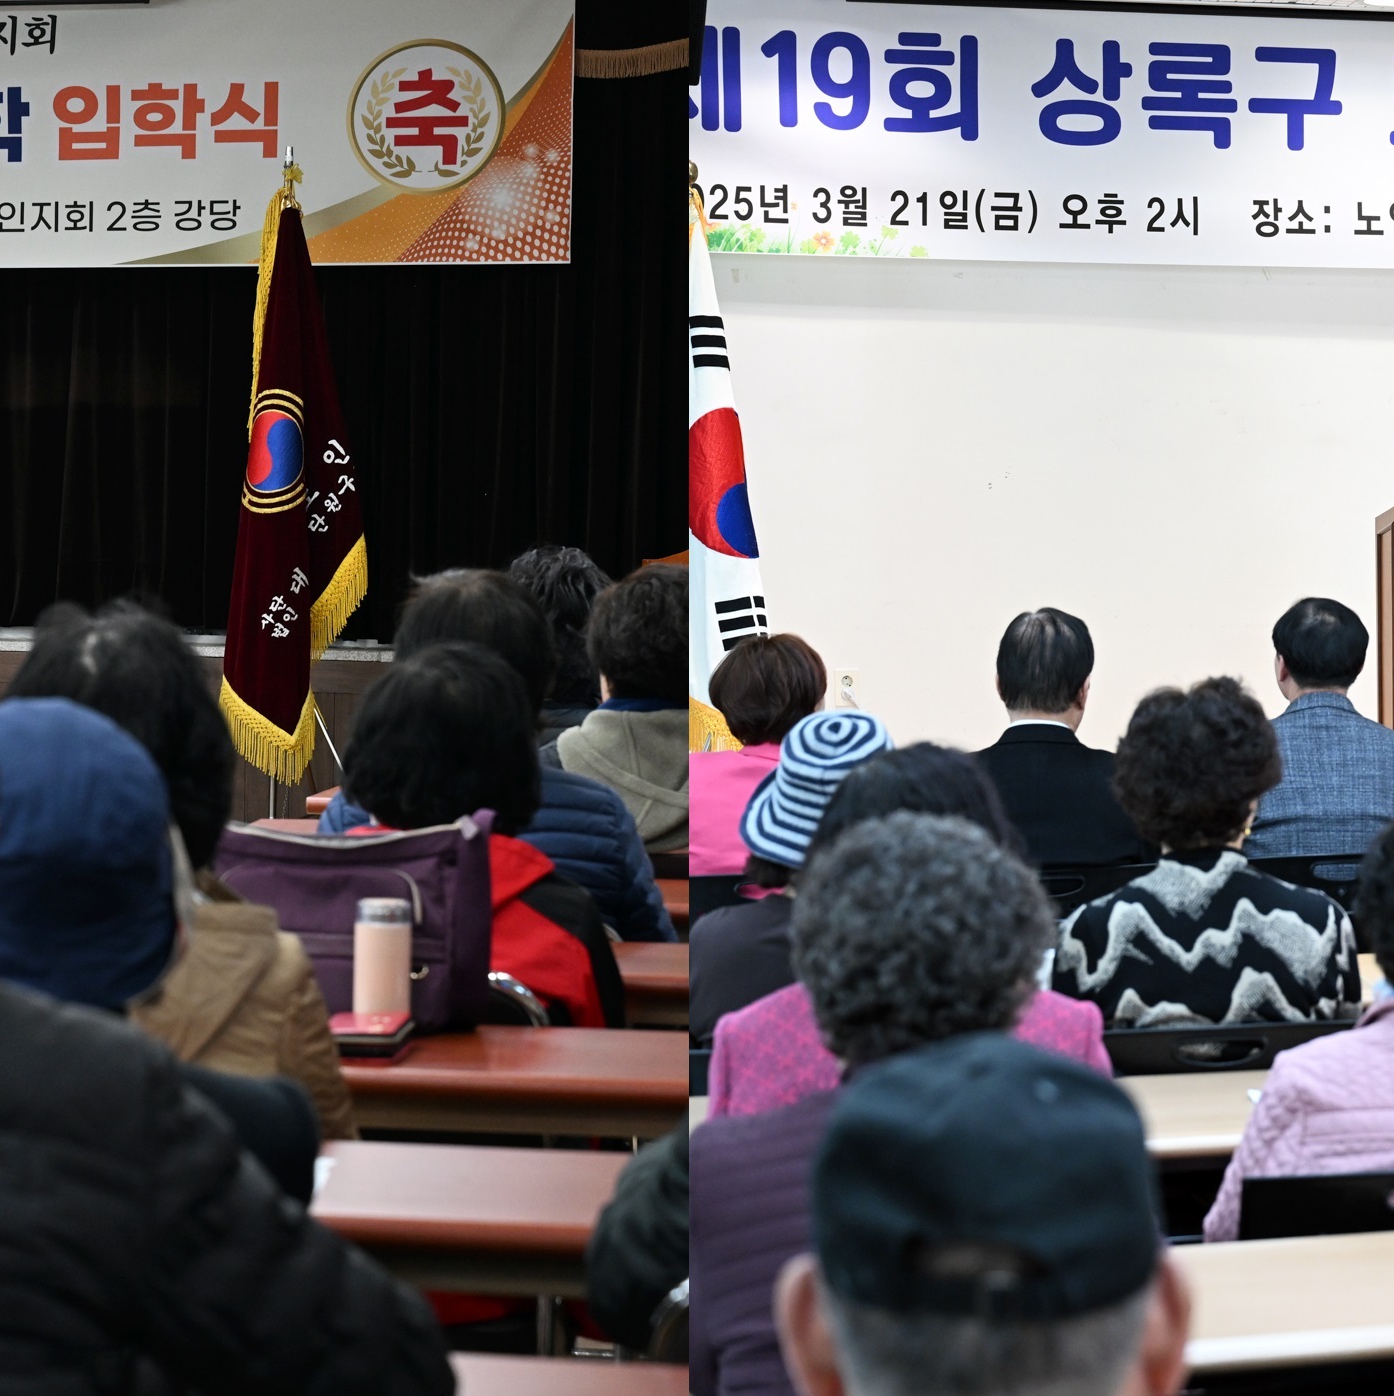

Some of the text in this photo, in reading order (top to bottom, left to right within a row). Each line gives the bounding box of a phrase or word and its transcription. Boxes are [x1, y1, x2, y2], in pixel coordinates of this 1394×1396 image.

[53, 81, 279, 160] 입학식
[393, 69, 470, 166] 축
[1031, 38, 1342, 150] 상록구
[107, 199, 161, 231] 2층
[175, 199, 241, 231] 강당
[812, 185, 867, 227] 3월
[890, 189, 1037, 233] 21일(금)
[1059, 193, 1126, 233] 오후
[1147, 196, 1198, 235] 2시
[1252, 198, 1330, 237] 장소:
